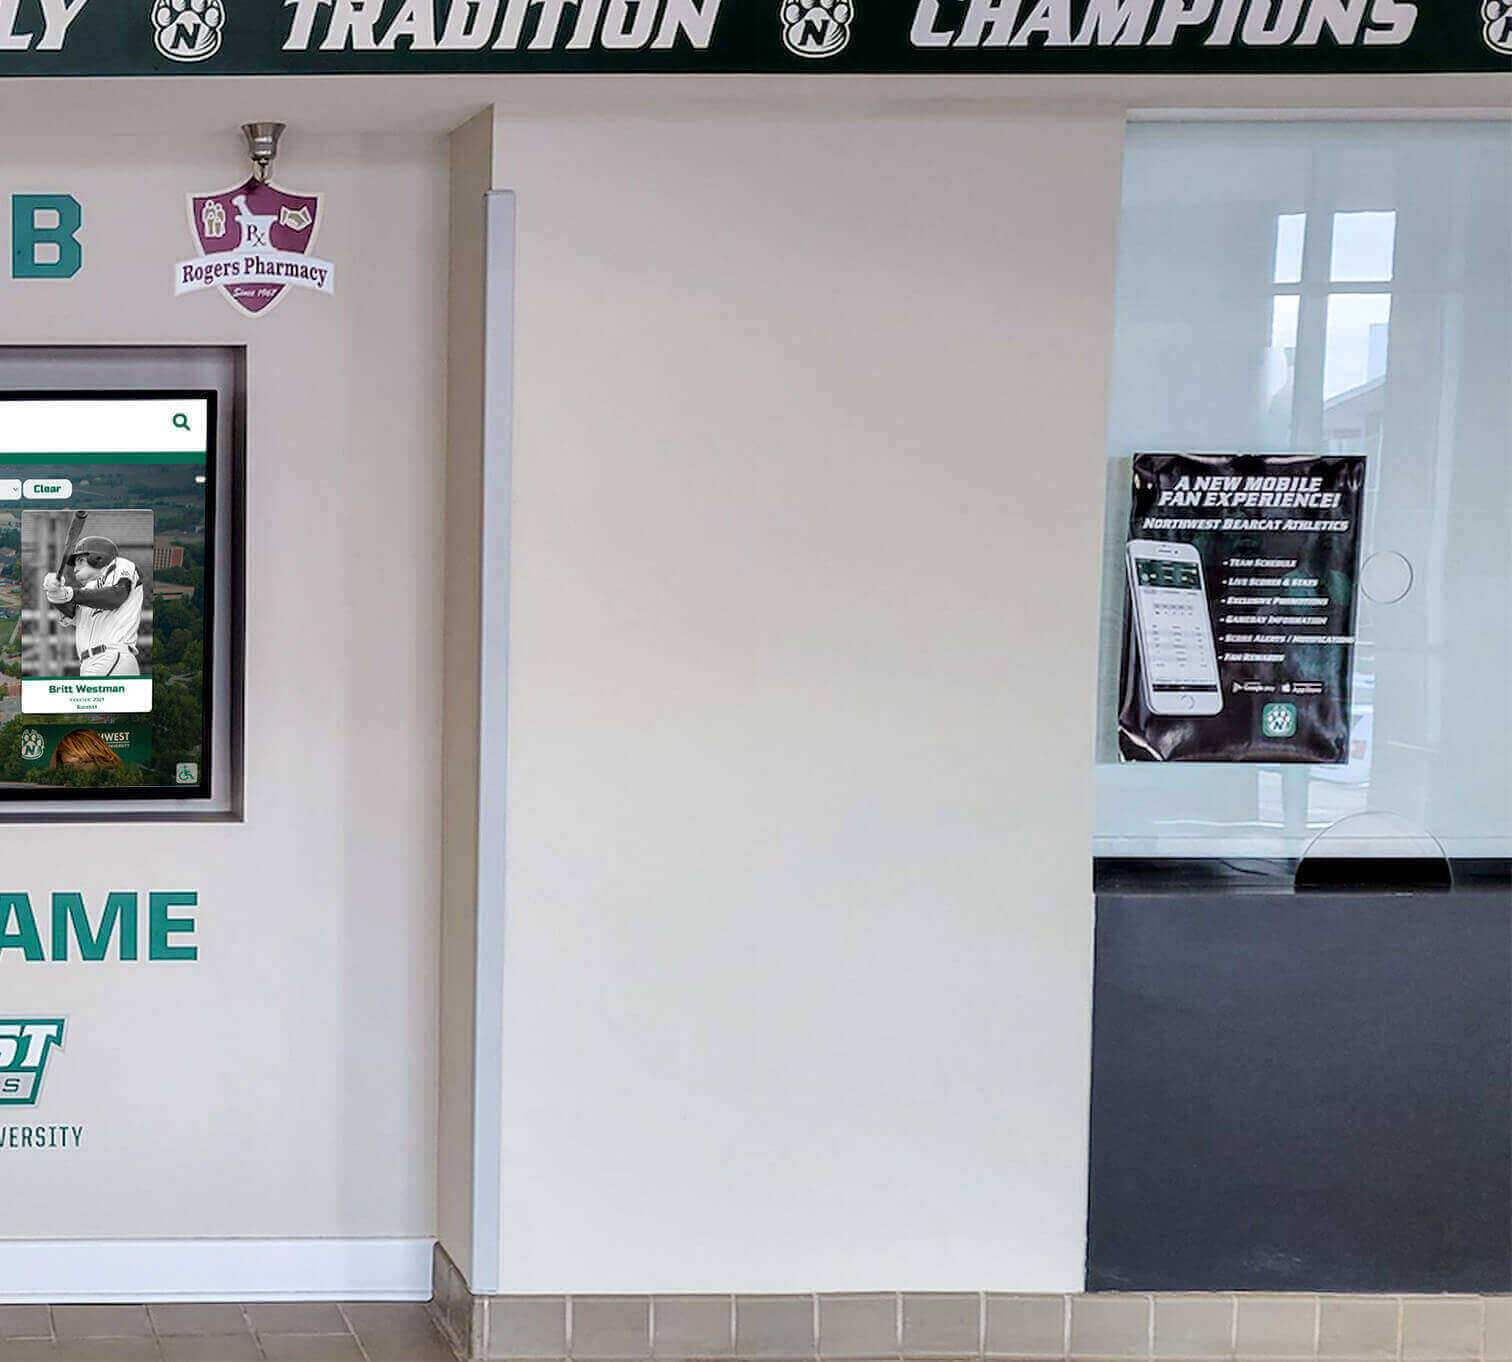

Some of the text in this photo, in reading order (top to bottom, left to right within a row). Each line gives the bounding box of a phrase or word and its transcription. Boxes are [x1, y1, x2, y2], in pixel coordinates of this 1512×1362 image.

[169, 22, 205, 49] N
[282, 0, 724, 49] TRADITION
[798, 19, 830, 46] N
[909, 0, 1419, 47] CHAMPIONS
[182, 255, 328, 288] Rogers Pharmacy
[33, 482, 62, 495] Clear
[1174, 476, 1324, 492] A NEW MOBILE
[1157, 491, 1342, 508] FAN EXPERIENCE!
[48, 684, 125, 694] Britt Westman
